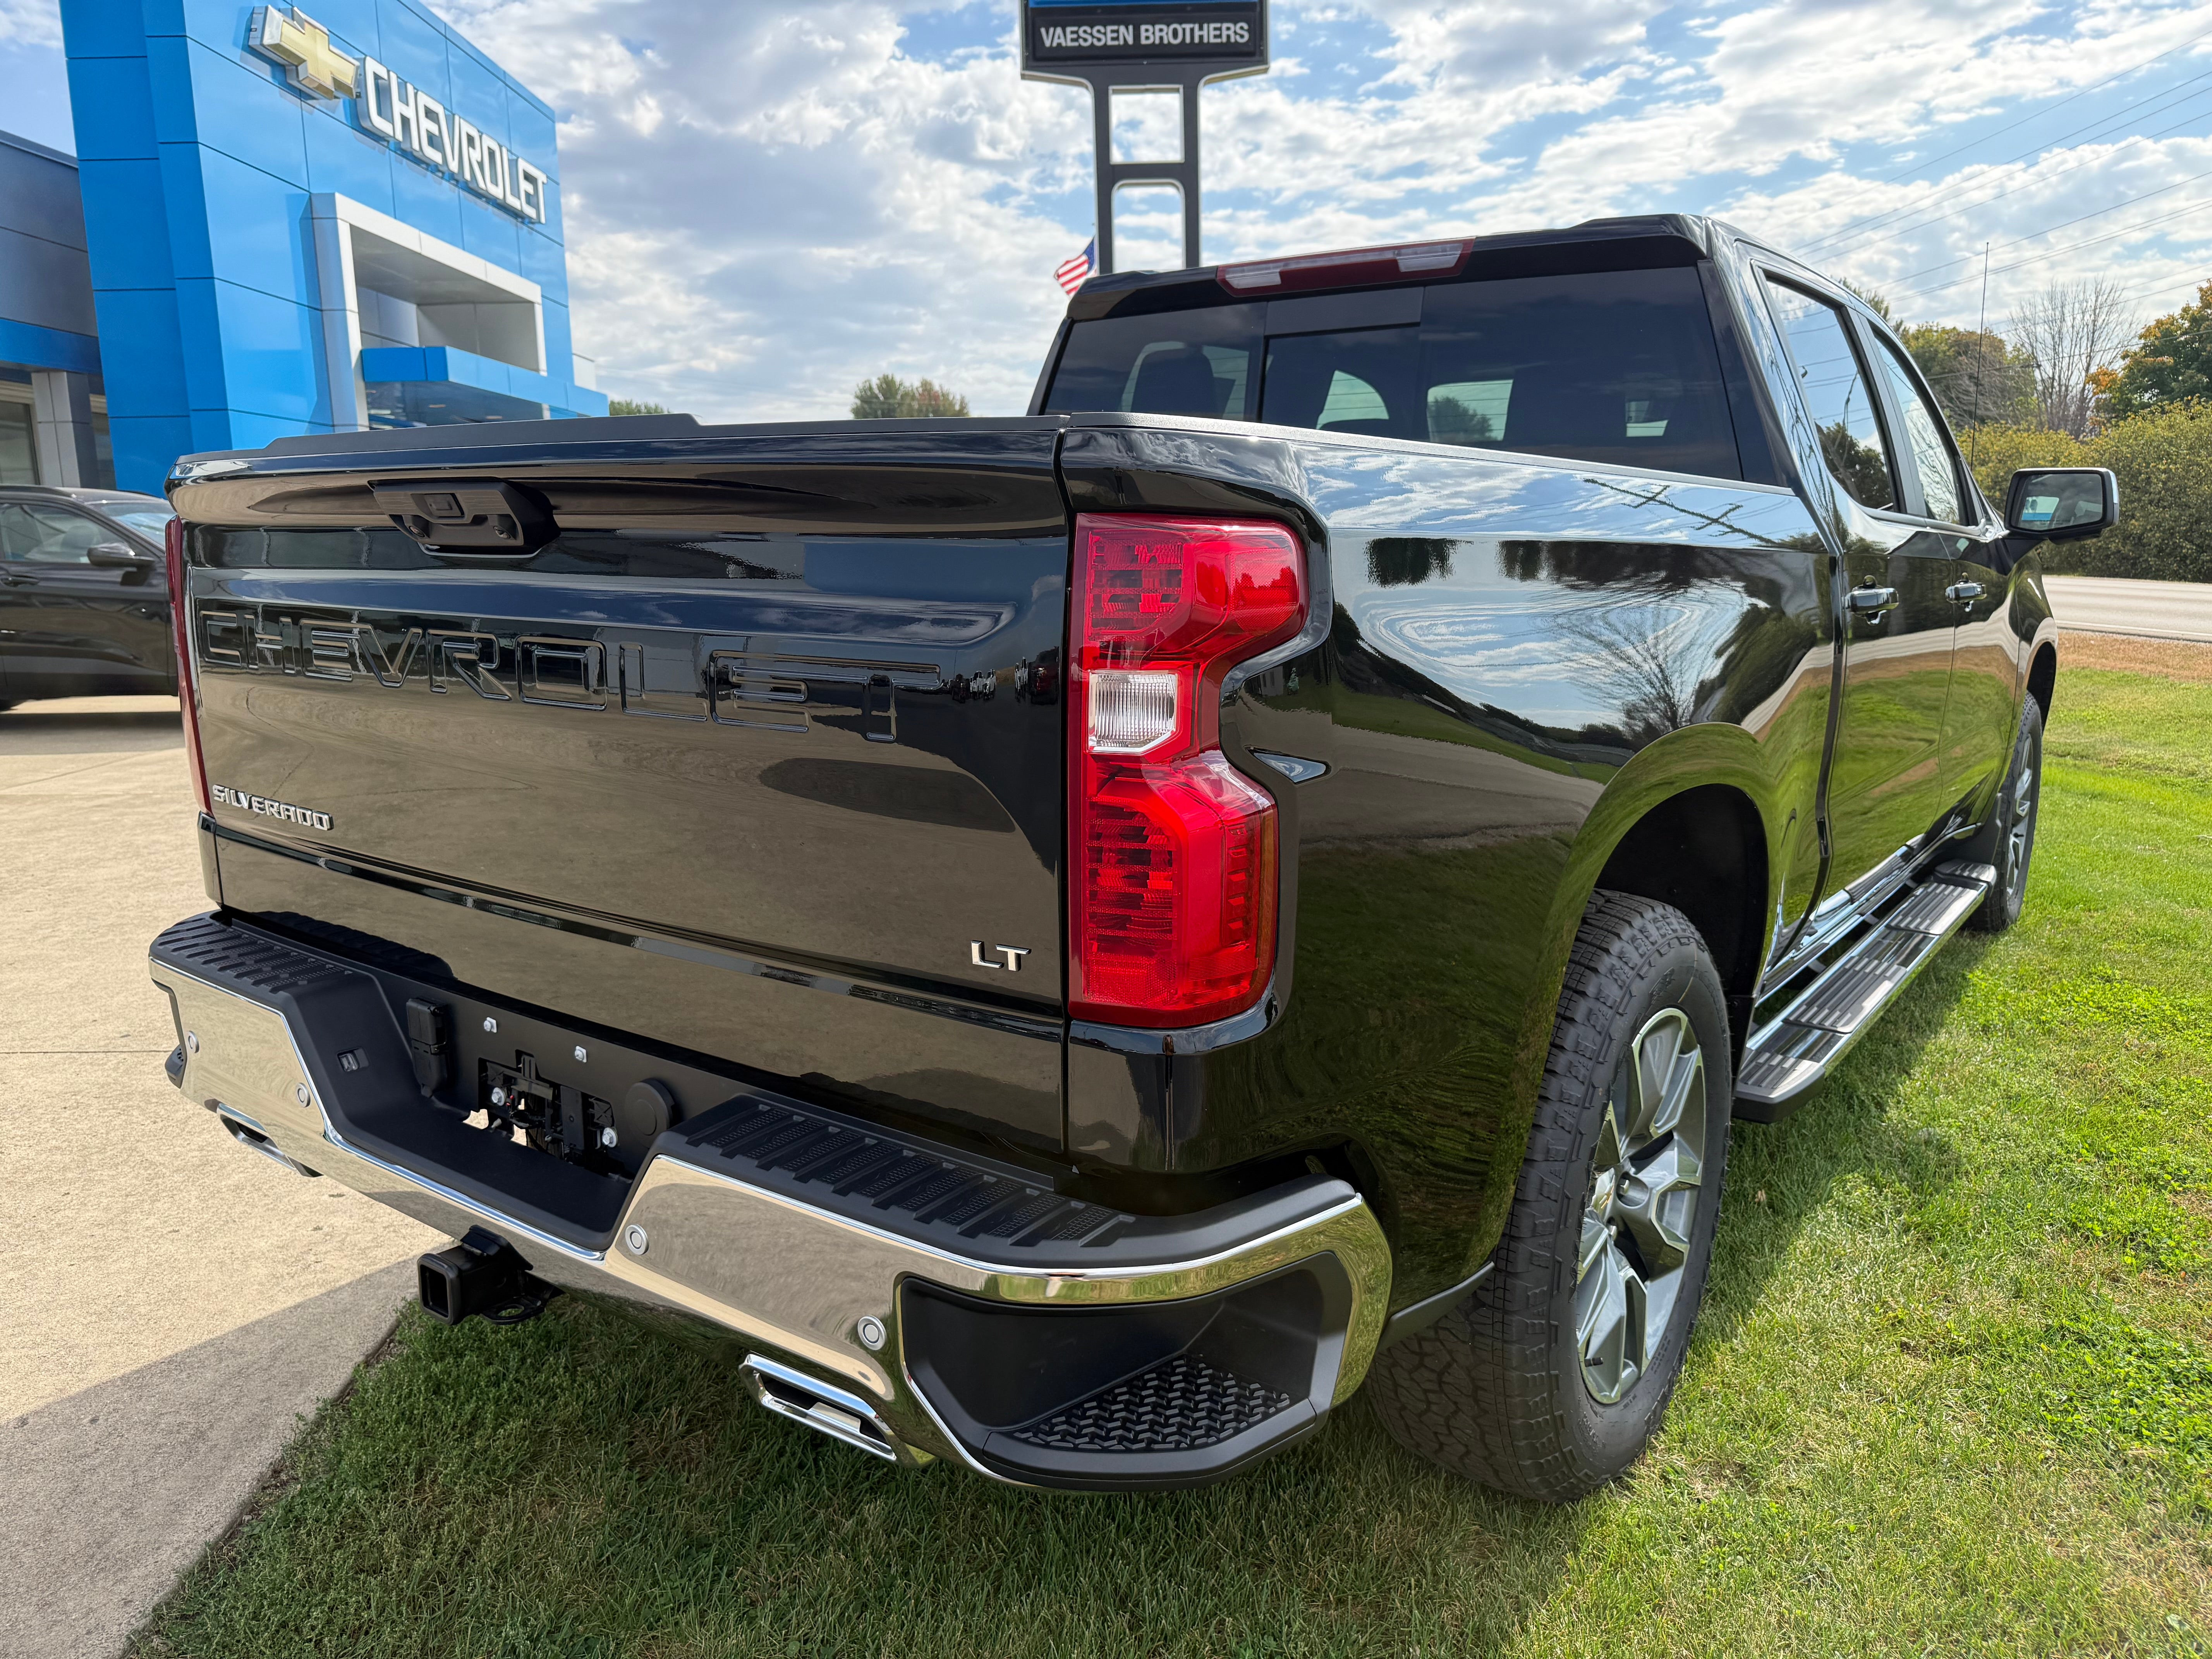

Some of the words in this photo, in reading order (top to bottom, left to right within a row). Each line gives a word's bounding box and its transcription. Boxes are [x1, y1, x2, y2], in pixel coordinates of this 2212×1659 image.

[1040, 24, 1133, 47] VAESSEN
[1140, 22, 1249, 45] BROTHERS
[364, 56, 547, 224] CHEVROLET
[198, 611, 940, 741] CHEVROLET
[212, 784, 334, 831] SILVERADO
[970, 939, 1032, 971] LT
